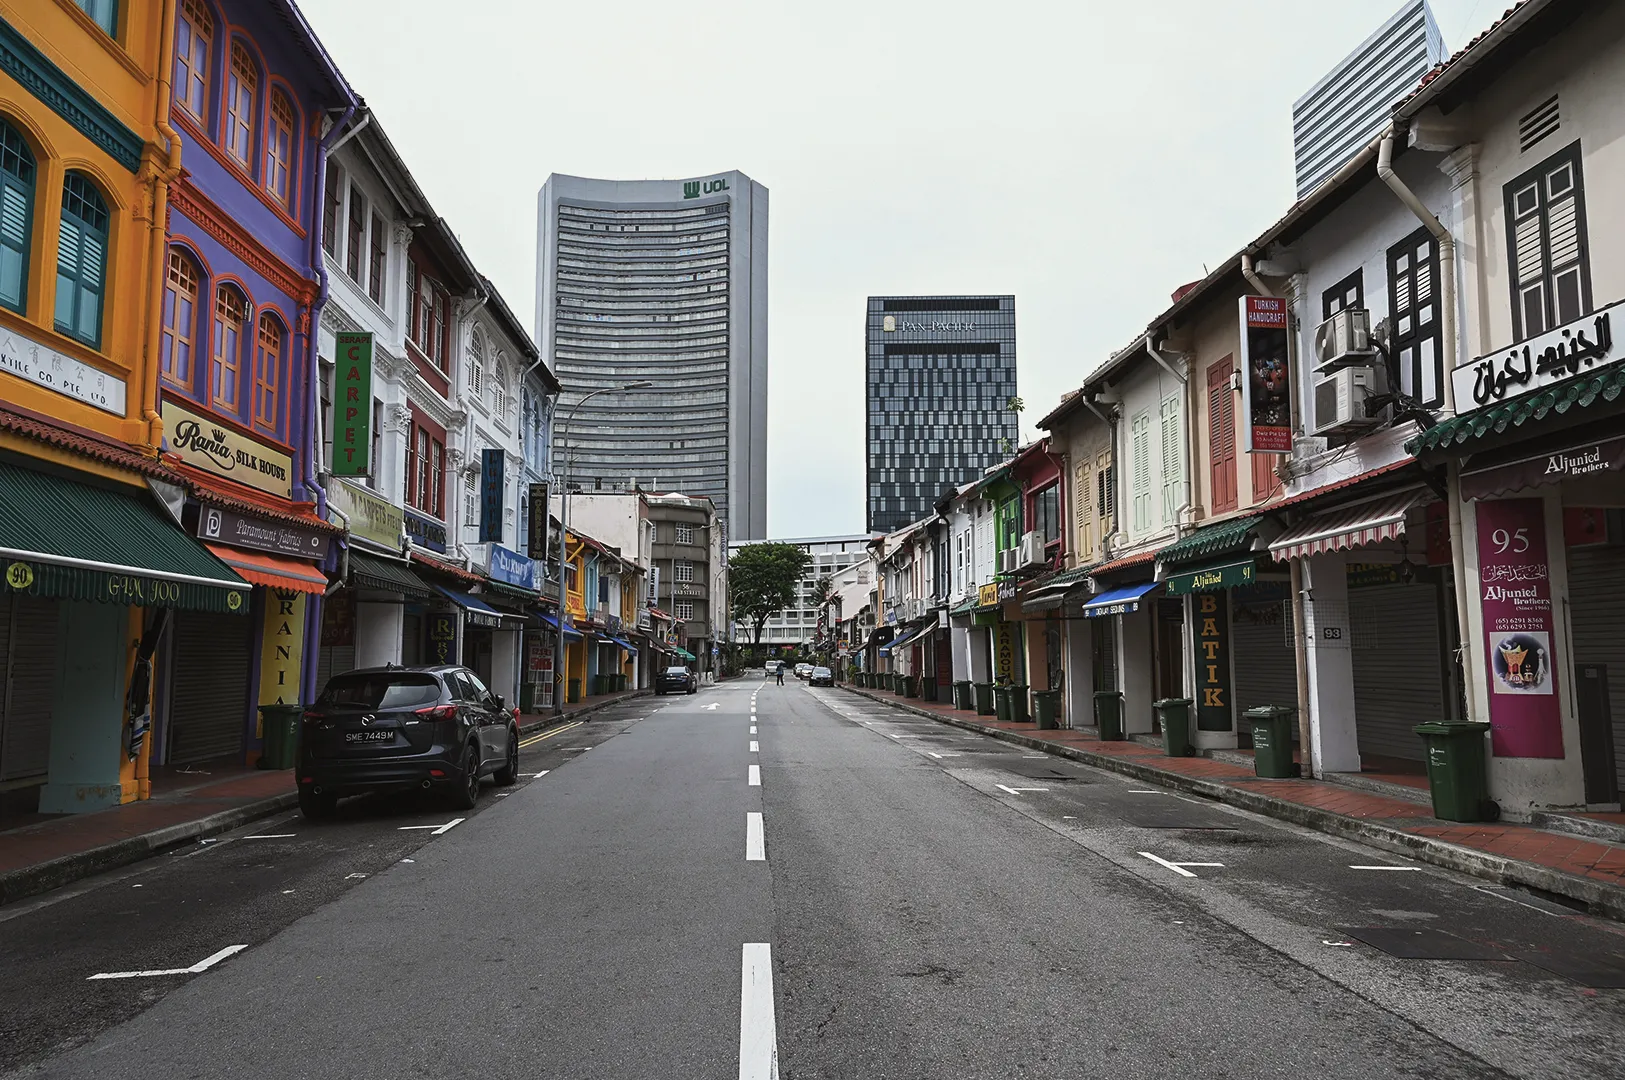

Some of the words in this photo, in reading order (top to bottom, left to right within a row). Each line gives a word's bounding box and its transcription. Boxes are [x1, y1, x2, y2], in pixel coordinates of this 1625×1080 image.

[703, 178, 730, 194] UOL
[1254, 299, 1279, 310] TURKISH
[1248, 312, 1285, 323] HANDICRAFT
[901, 321, 926, 332] PAN
[931, 320, 978, 332] PACIFIC
[38, 370, 56, 386] CO.
[344, 346, 360, 463] CARPET
[173, 420, 235, 470] Rania
[236, 449, 257, 470] SILK
[259, 458, 286, 482] HOUSE
[1545, 446, 1600, 475] Aljunied
[1572, 460, 1609, 475] Brothers
[236, 519, 277, 541] Paramount
[277, 528, 302, 547] Fabrics
[1491, 527, 1529, 555] 95
[12, 567, 27, 585] 90
[1191, 571, 1222, 589] Aljunied
[1242, 566, 1251, 580] 91
[149, 580, 180, 602] JOO
[1168, 581, 1175, 592] 91
[1483, 585, 1537, 603] Aljunied
[229, 593, 239, 607] 90
[1324, 628, 1340, 639] 93
[1200, 595, 1224, 707] BATIK
[345, 732, 363, 742] SME
[364, 731, 394, 741] 7449M
